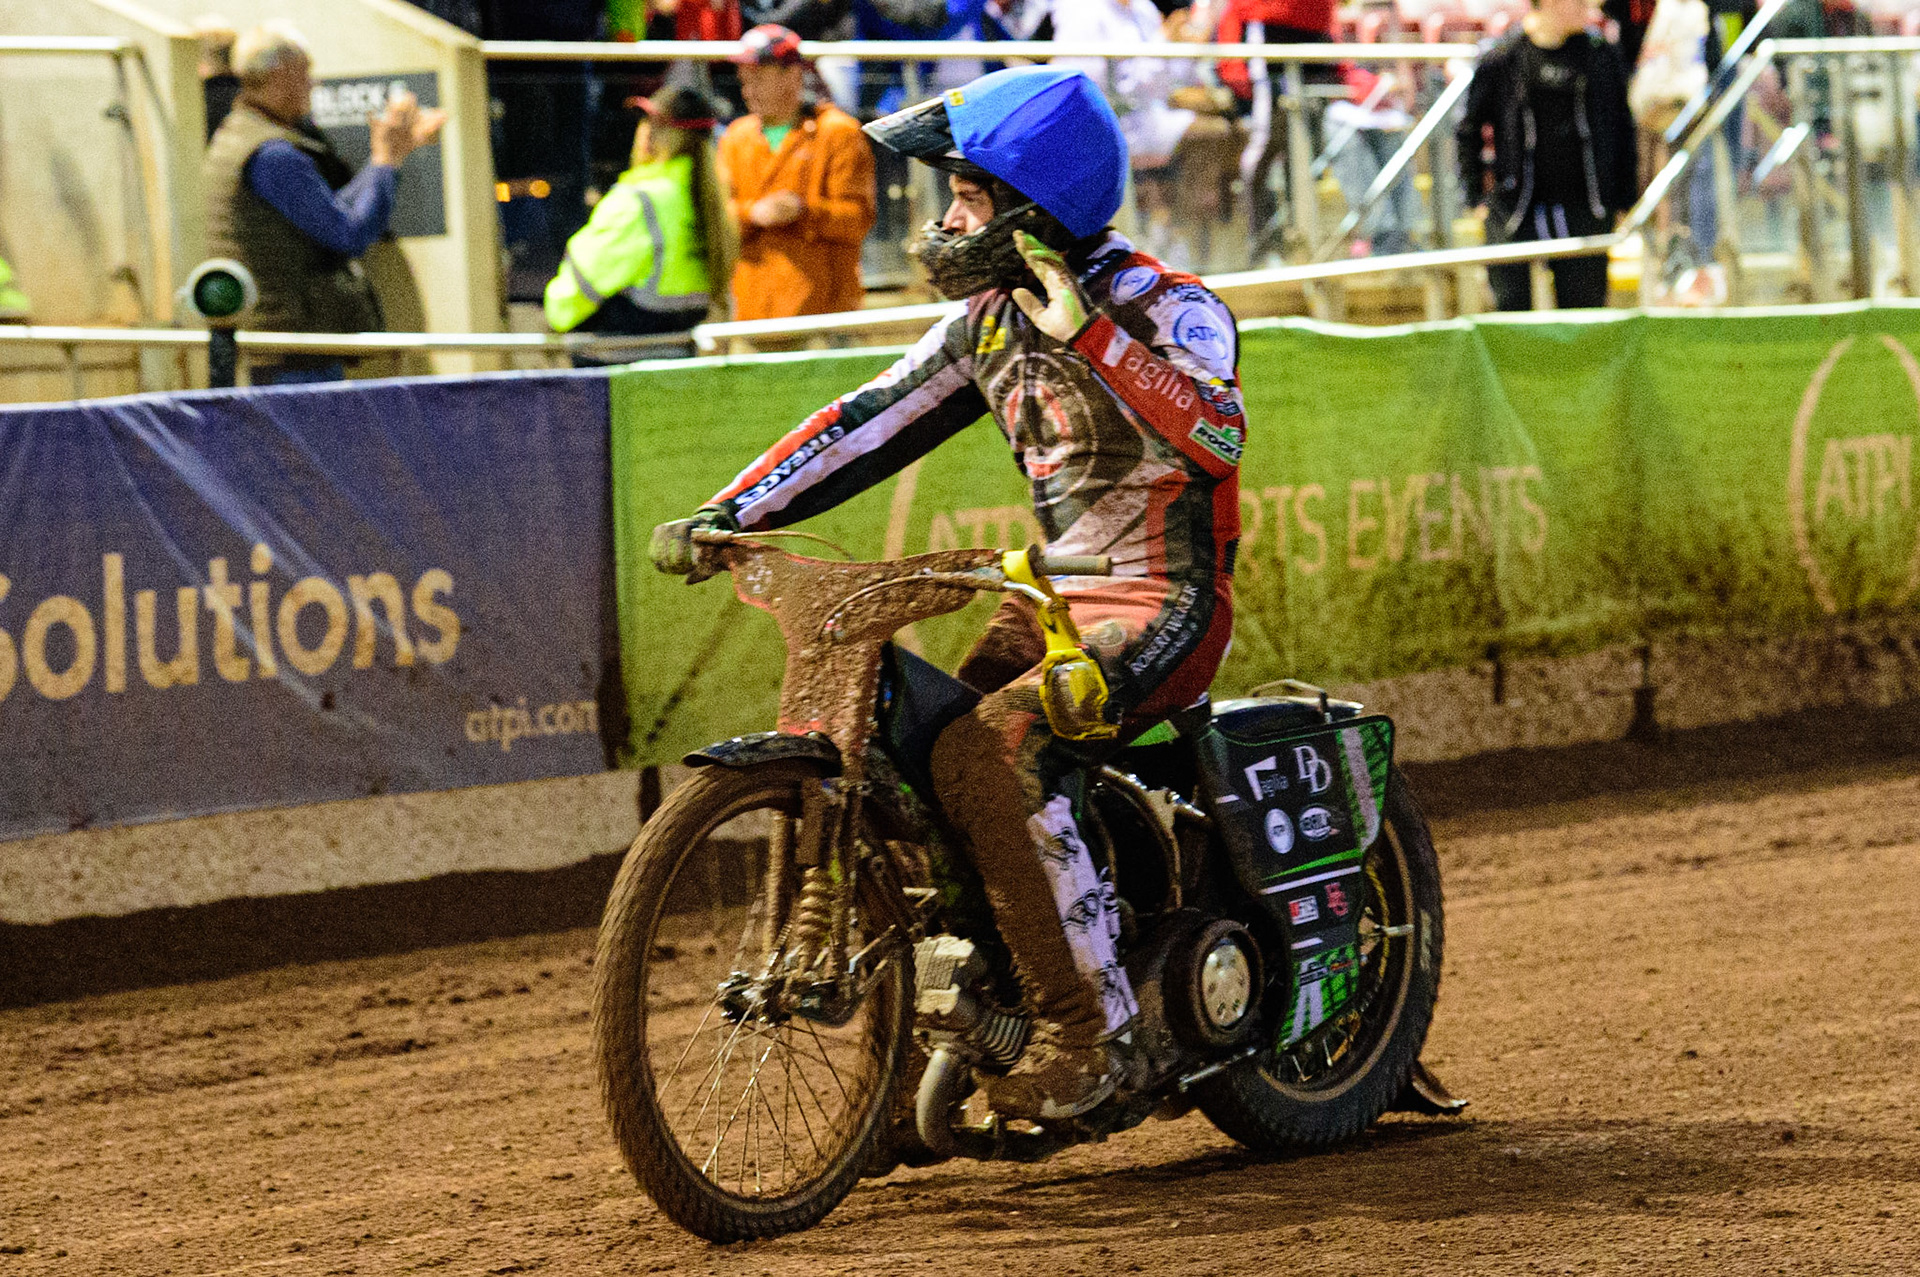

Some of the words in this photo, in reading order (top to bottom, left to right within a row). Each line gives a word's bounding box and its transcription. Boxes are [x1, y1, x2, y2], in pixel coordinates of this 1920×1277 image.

[1239, 483, 1327, 577] RTS
[1349, 465, 1546, 570] EVENTS
[0, 543, 461, 700] olutions
